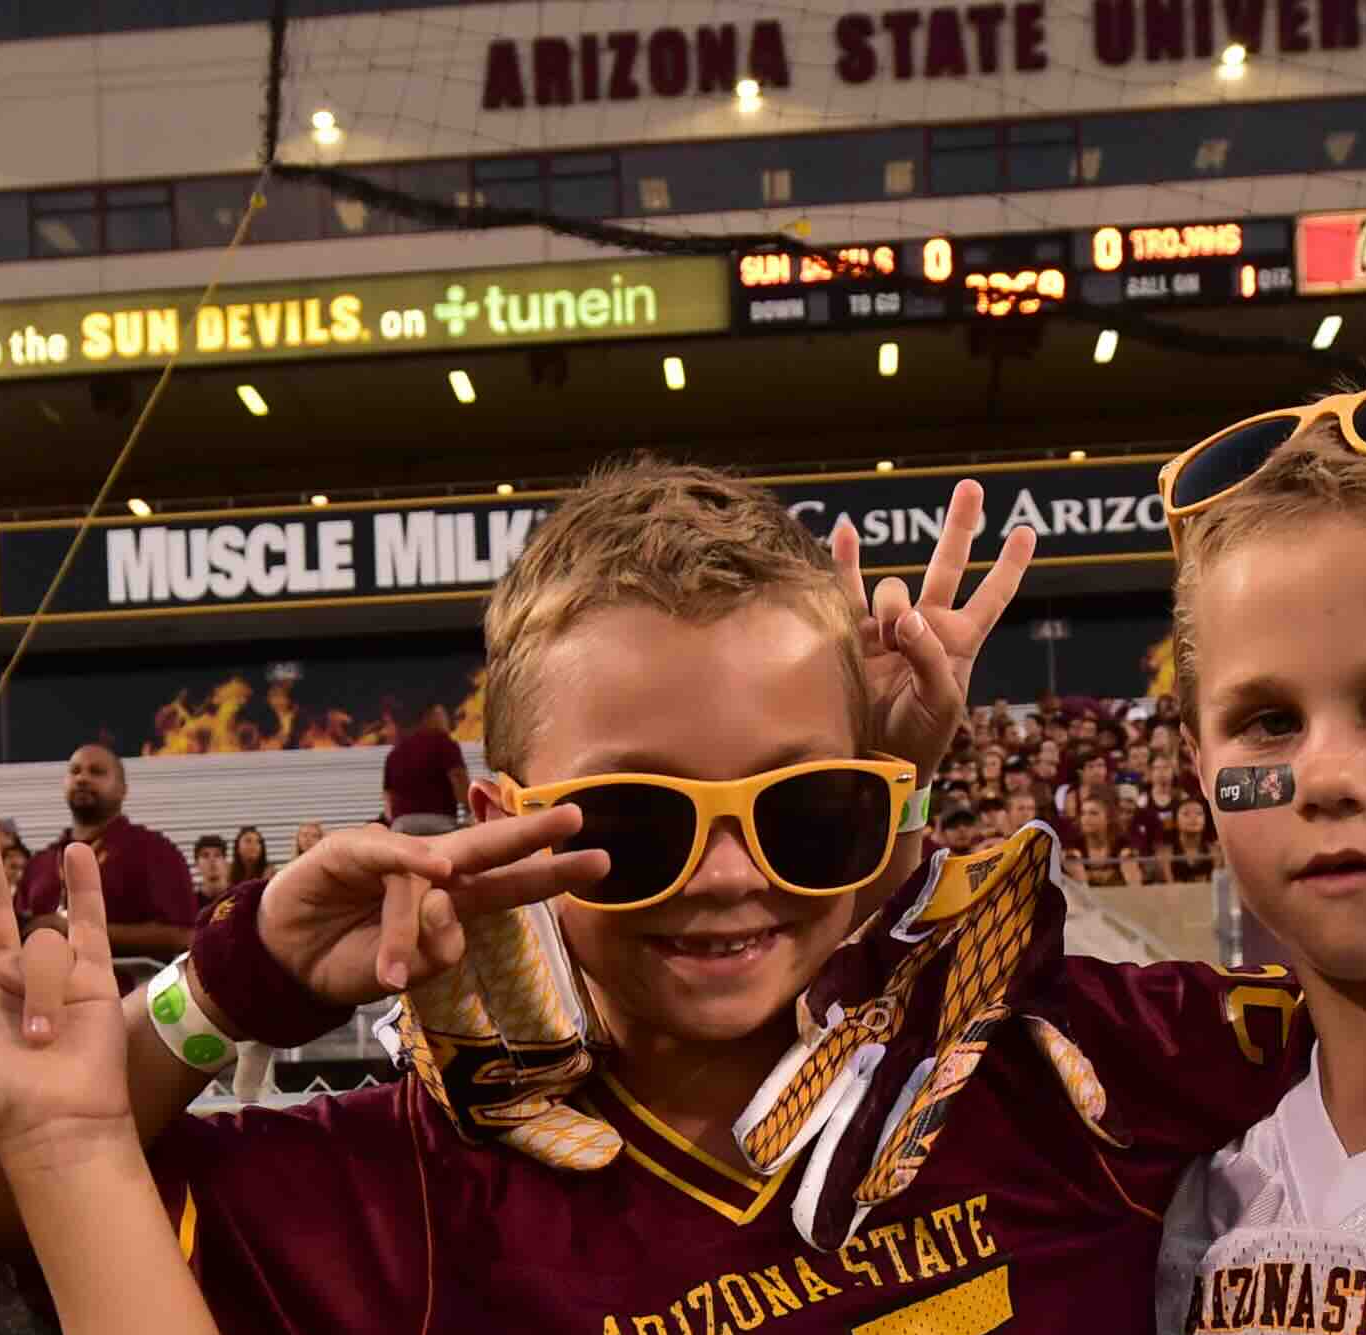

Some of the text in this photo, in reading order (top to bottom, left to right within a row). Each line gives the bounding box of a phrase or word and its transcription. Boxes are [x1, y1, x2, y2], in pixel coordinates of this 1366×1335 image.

[483, 20, 790, 109] ARIZONA
[835, 3, 1048, 84] STATE
[923, 238, 953, 282] 0
[1093, 224, 1242, 270] 0 TROJANS
[10, 326, 69, 366] the
[81, 308, 179, 360] SUN
[380, 308, 426, 338] on
[750, 299, 803, 322] DOWN
[789, 495, 986, 548] CASIN
[107, 508, 533, 604] MUSCLE MILK
[1219, 781, 1240, 802] nrg
[838, 1194, 997, 1287] STATE
